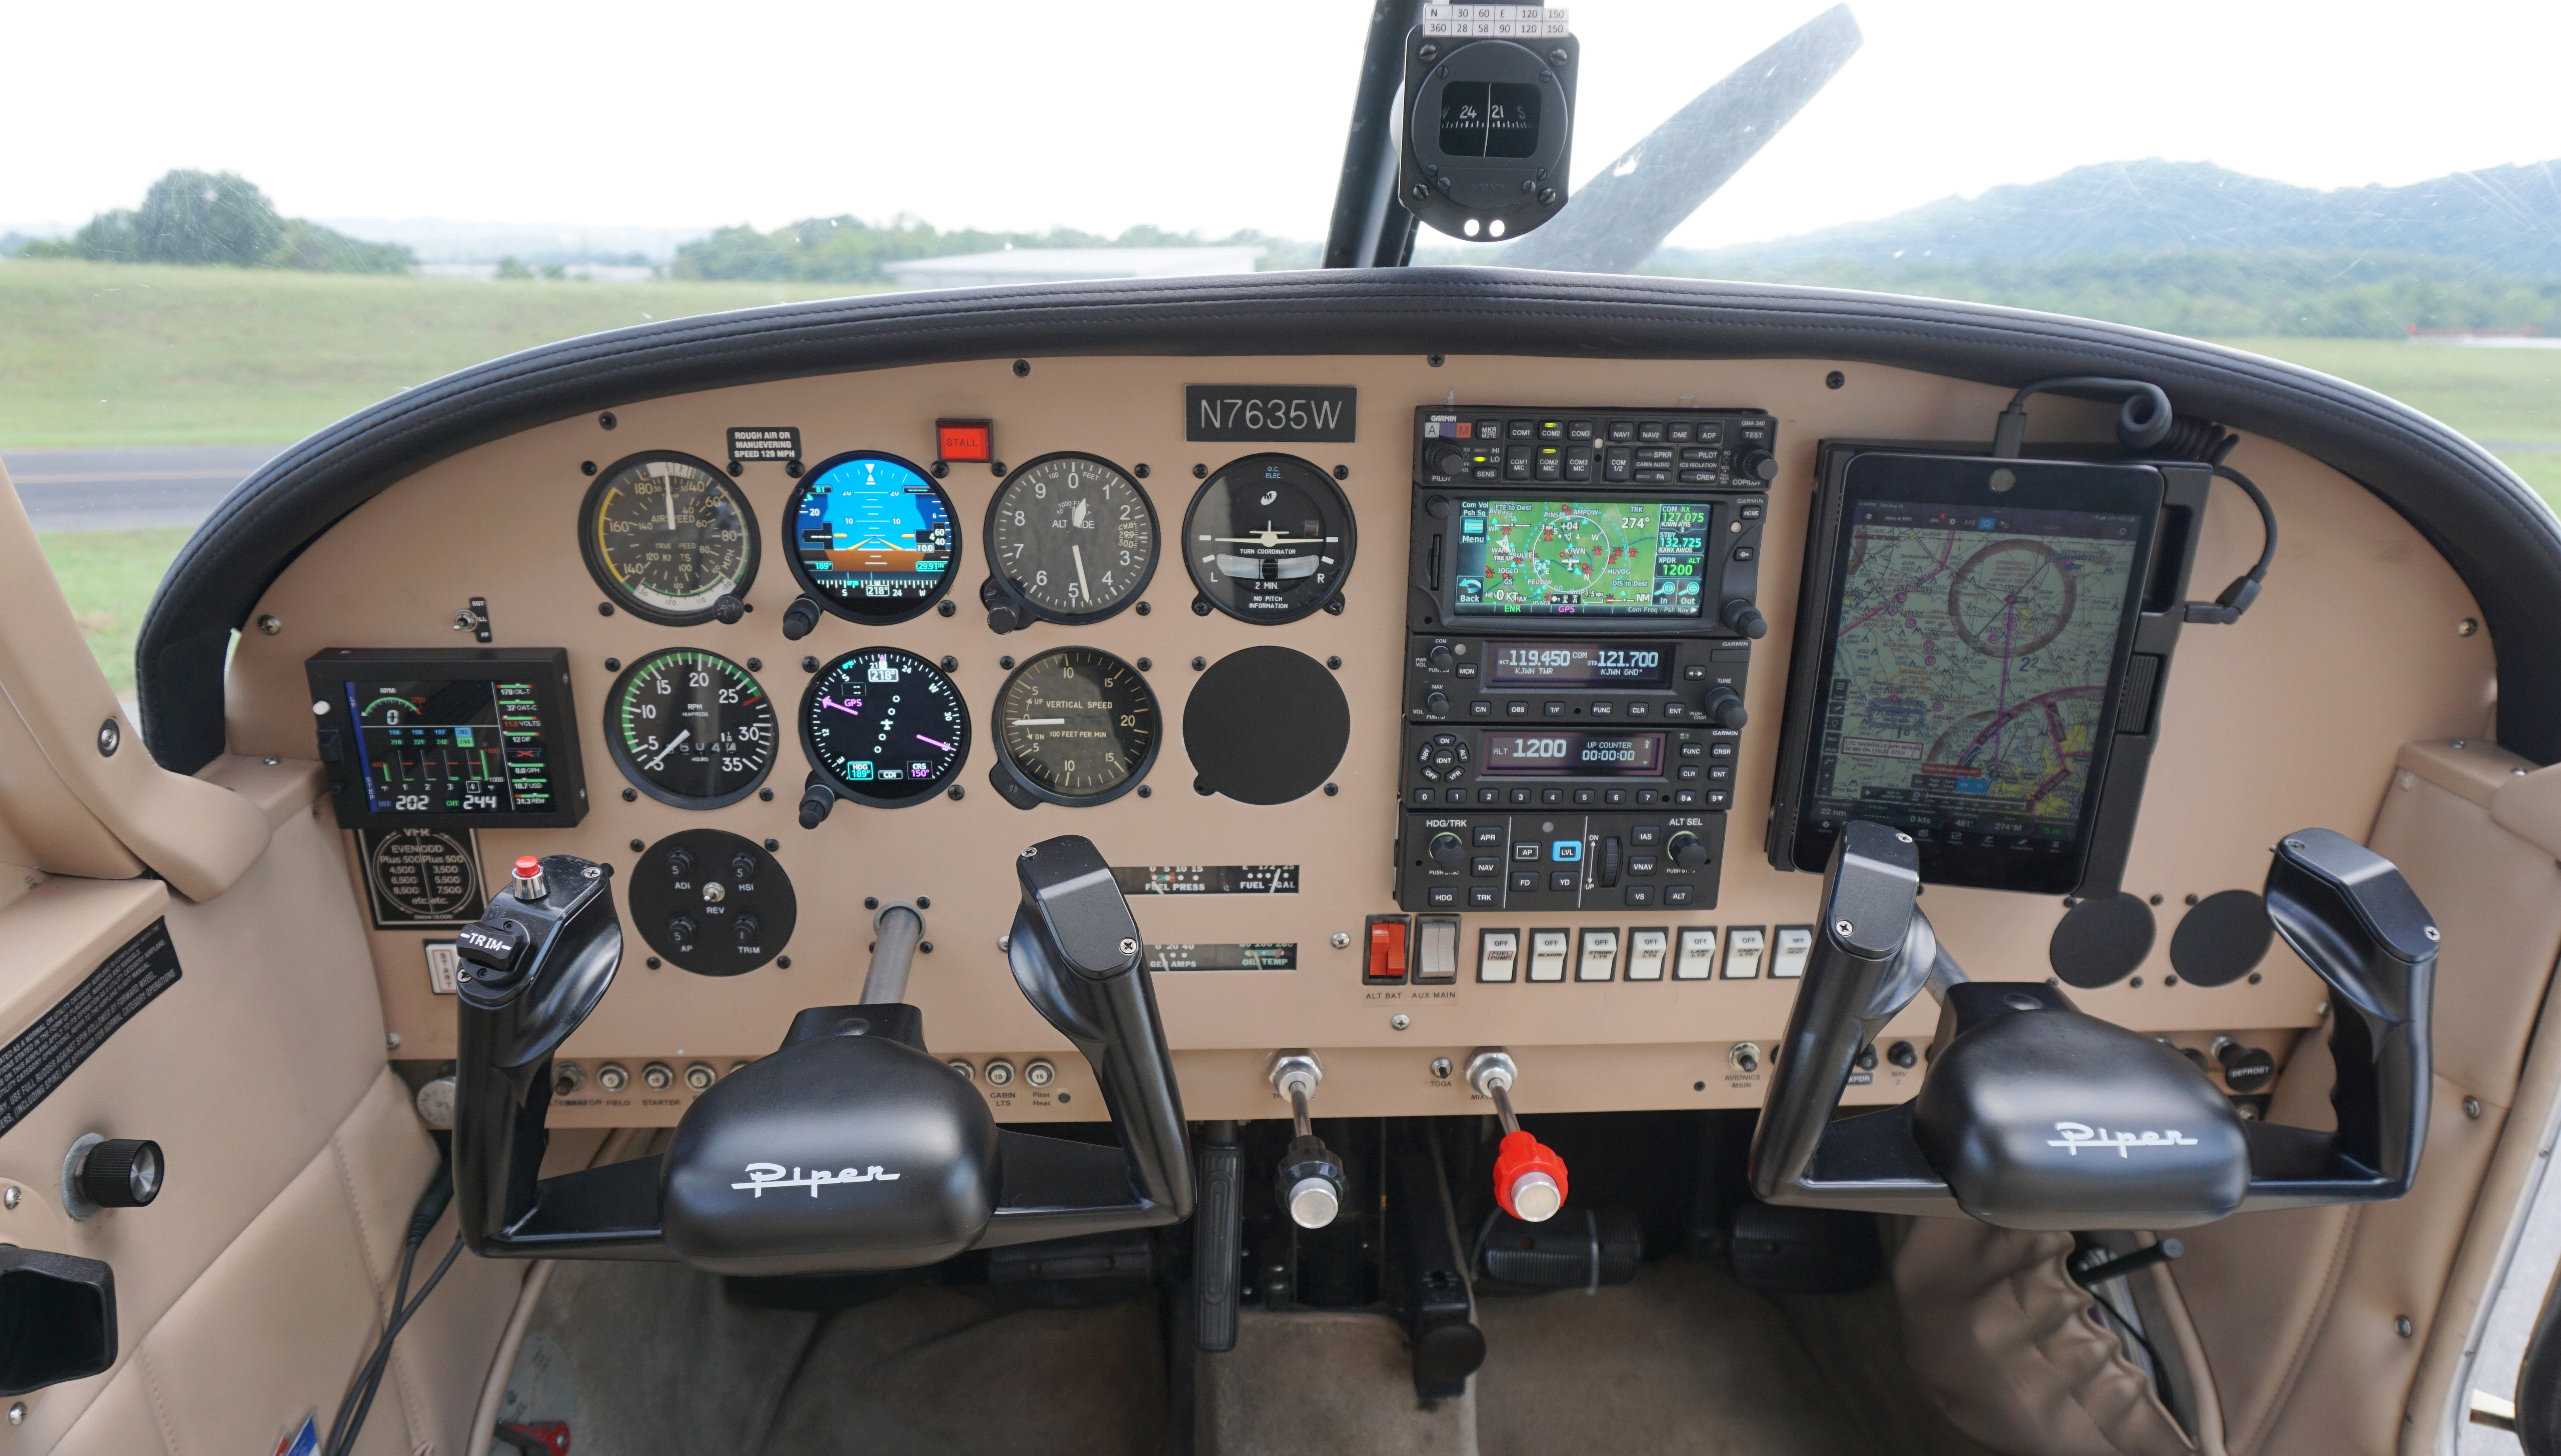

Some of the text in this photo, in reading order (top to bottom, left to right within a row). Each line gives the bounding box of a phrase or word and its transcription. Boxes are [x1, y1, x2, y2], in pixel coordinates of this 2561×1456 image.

[1522, 9, 1538, 17] 120
[1548, 10, 1564, 18] 150
[1430, 24, 1446, 32] 360
[1547, 25, 1563, 33] 150
[1459, 105, 1504, 119] 24 21
[1202, 399, 1342, 429] N7635W
[947, 439, 978, 447] STALL
[1083, 472, 1100, 480] FEET
[635, 483, 653, 495] 180
[1621, 517, 1650, 529] 274°
[1663, 513, 1704, 522] 127.075
[610, 522, 629, 532] 160
[1660, 538, 1702, 547] 132.725
[1663, 565, 1693, 575] 1200
[868, 586, 888, 595] 218°
[1510, 650, 1570, 666] 119.450
[1598, 651, 1658, 667] 121.700
[690, 673, 709, 687] 20
[1513, 739, 1566, 757] 1200
[1583, 750, 1635, 760] 00:00:00
[396, 796, 429, 810] 202
[464, 795, 497, 810] 244
[2231, 1066, 2270, 1077] DEFROST
[2047, 1122, 2198, 1158] Piper
[731, 1163, 900, 1198] Piper
